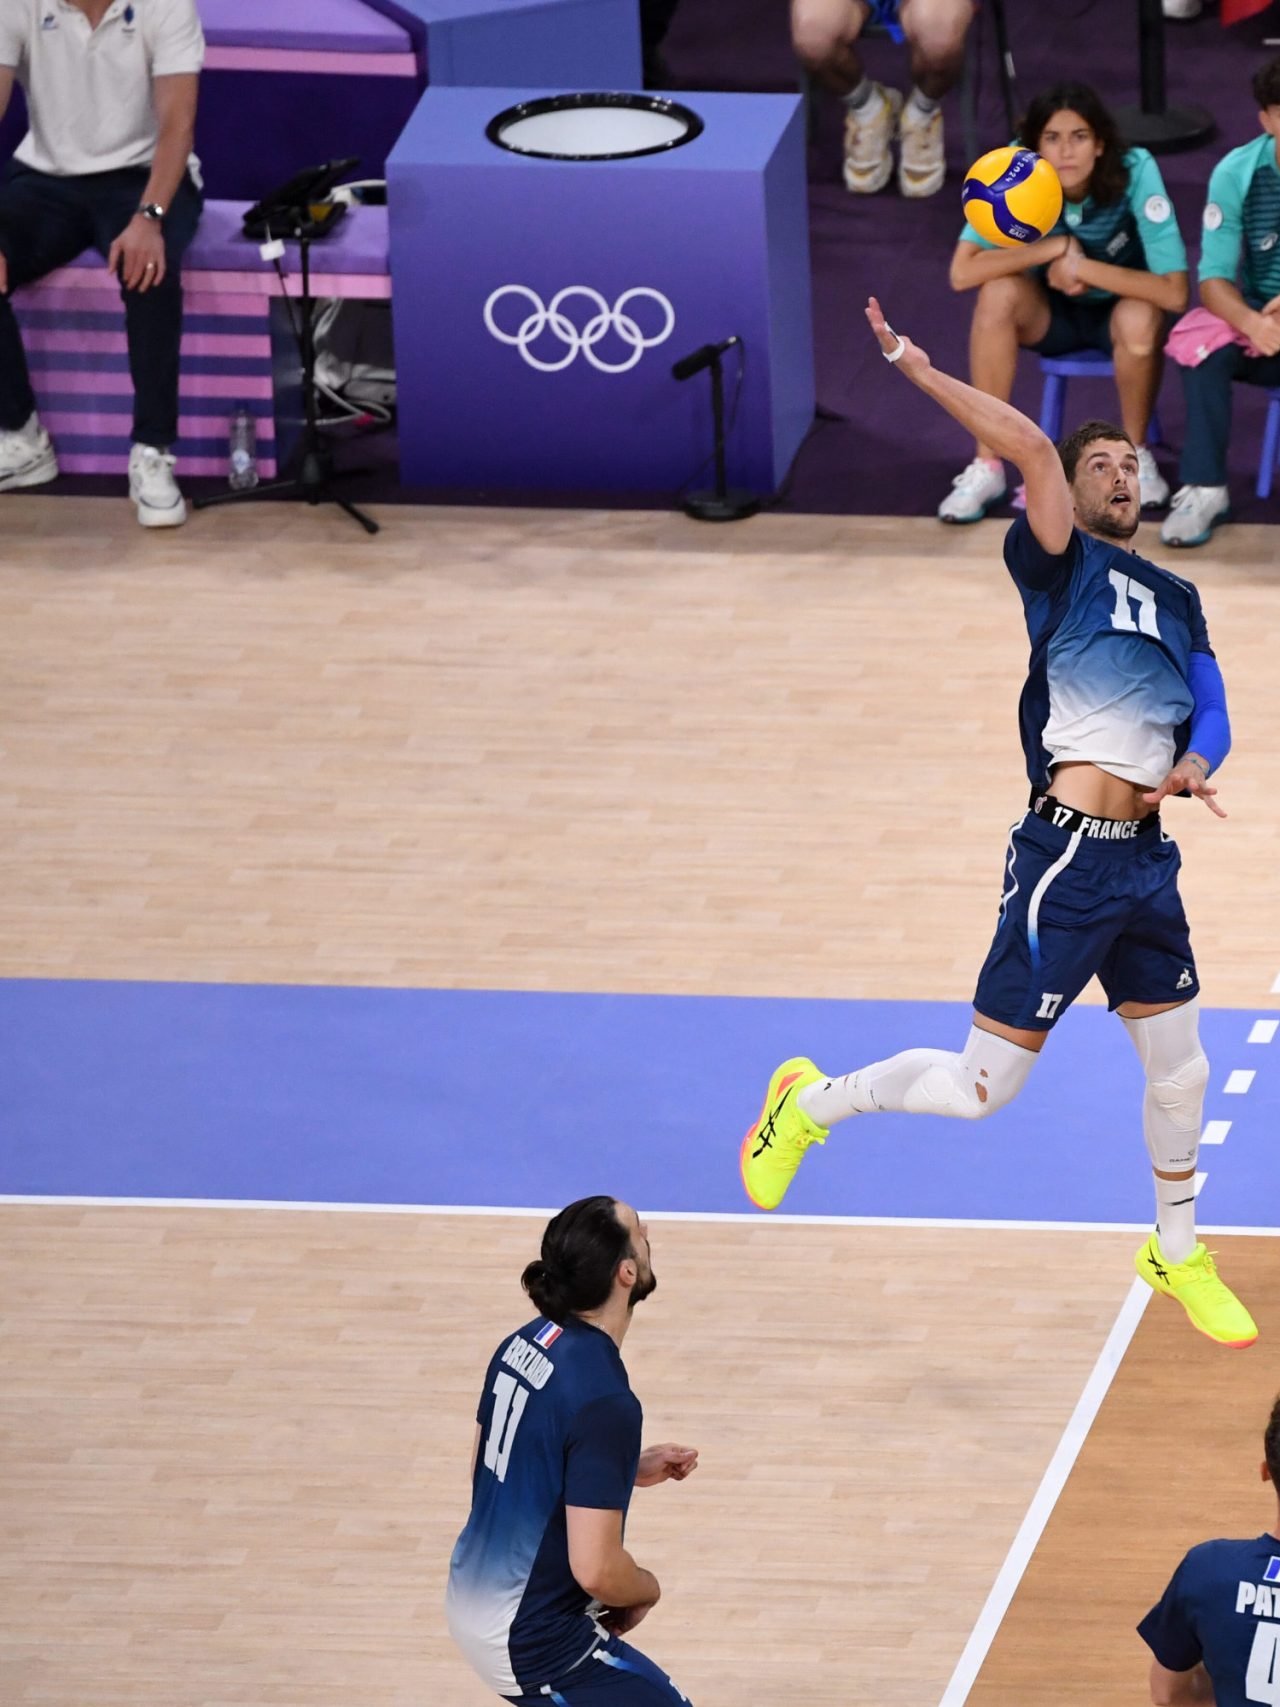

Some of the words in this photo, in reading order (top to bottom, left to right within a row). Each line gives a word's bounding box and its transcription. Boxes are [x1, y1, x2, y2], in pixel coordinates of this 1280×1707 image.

[1005, 161, 1025, 183] 2024
[1108, 568, 1162, 641] 17
[1051, 806, 1074, 828] 17
[1077, 816, 1140, 840] FRANCE
[1035, 992, 1064, 1019] 17
[501, 1334, 554, 1391] BRIZARD
[484, 1370, 530, 1483] 11
